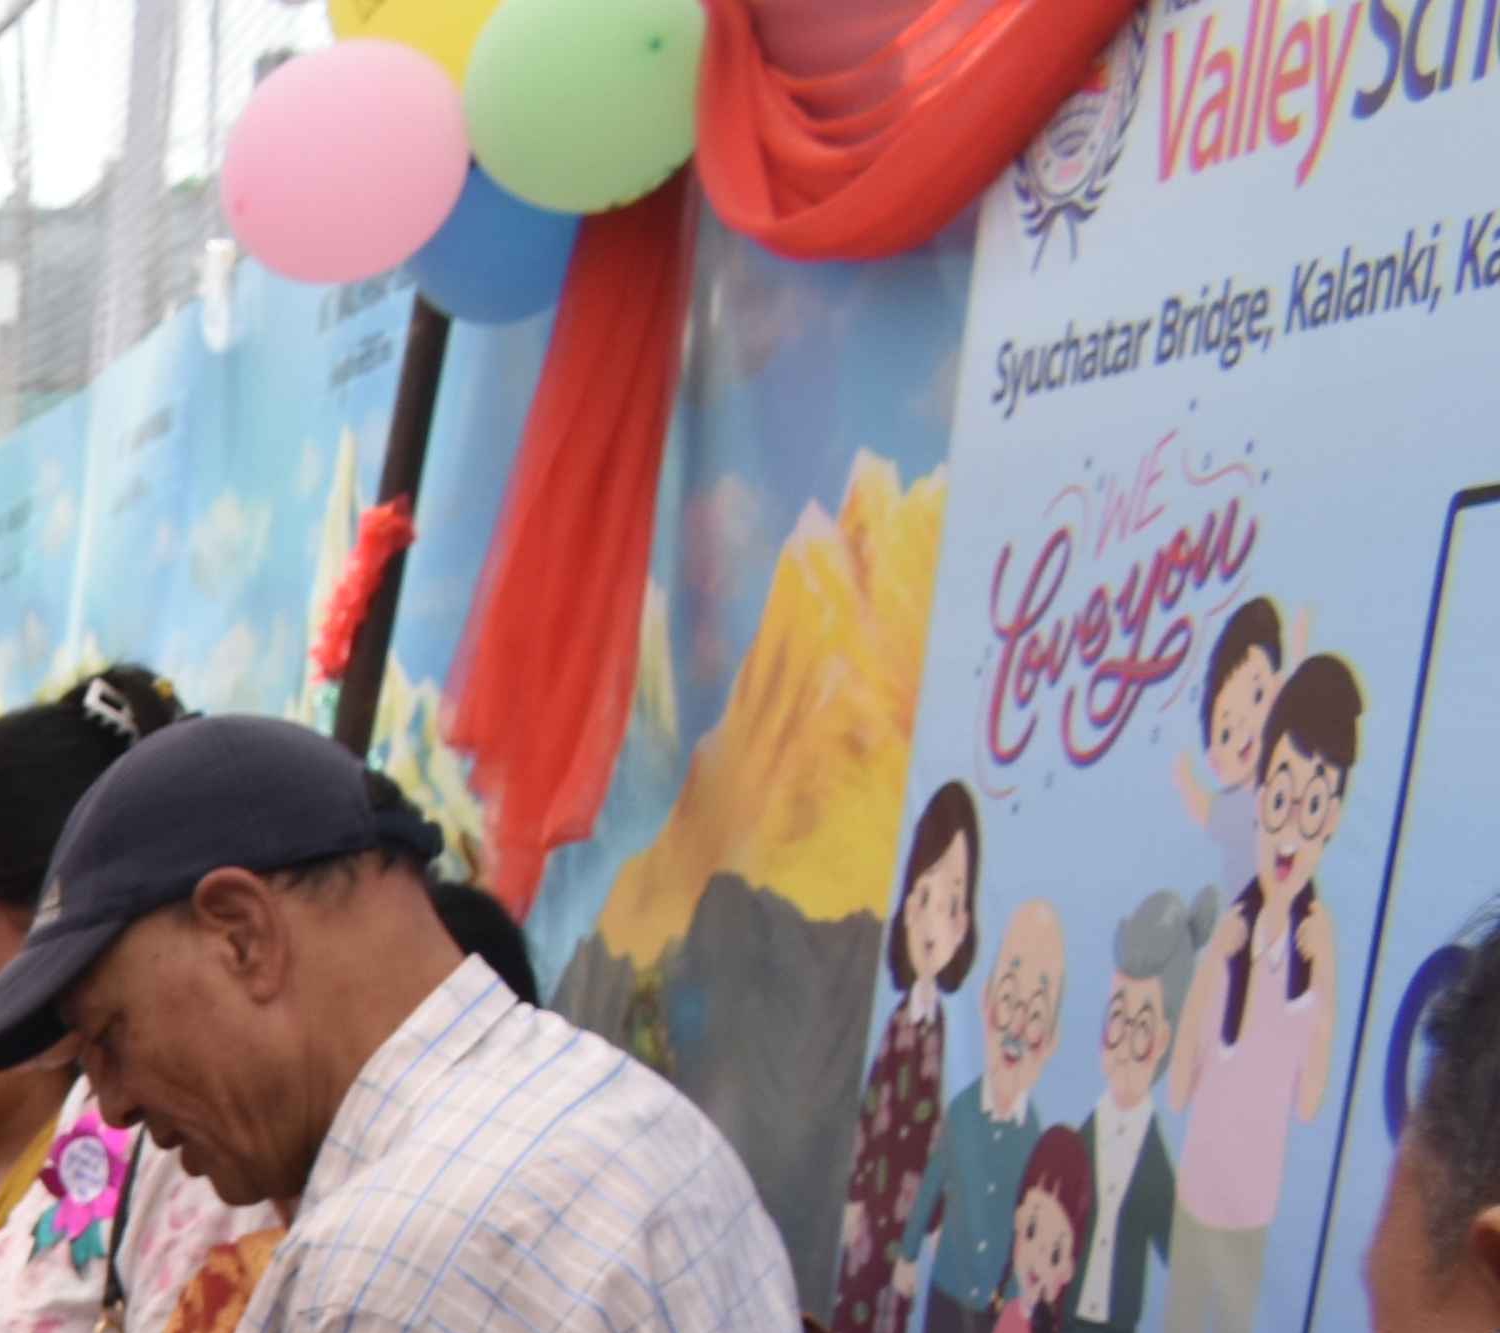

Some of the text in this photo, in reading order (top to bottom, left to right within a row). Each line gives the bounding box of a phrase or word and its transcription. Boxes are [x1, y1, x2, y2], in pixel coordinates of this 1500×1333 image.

[991, 318, 1153, 420] Syuchatar
[1154, 276, 1273, 371] Bridge,
[1284, 222, 1442, 335] Kalanki,
